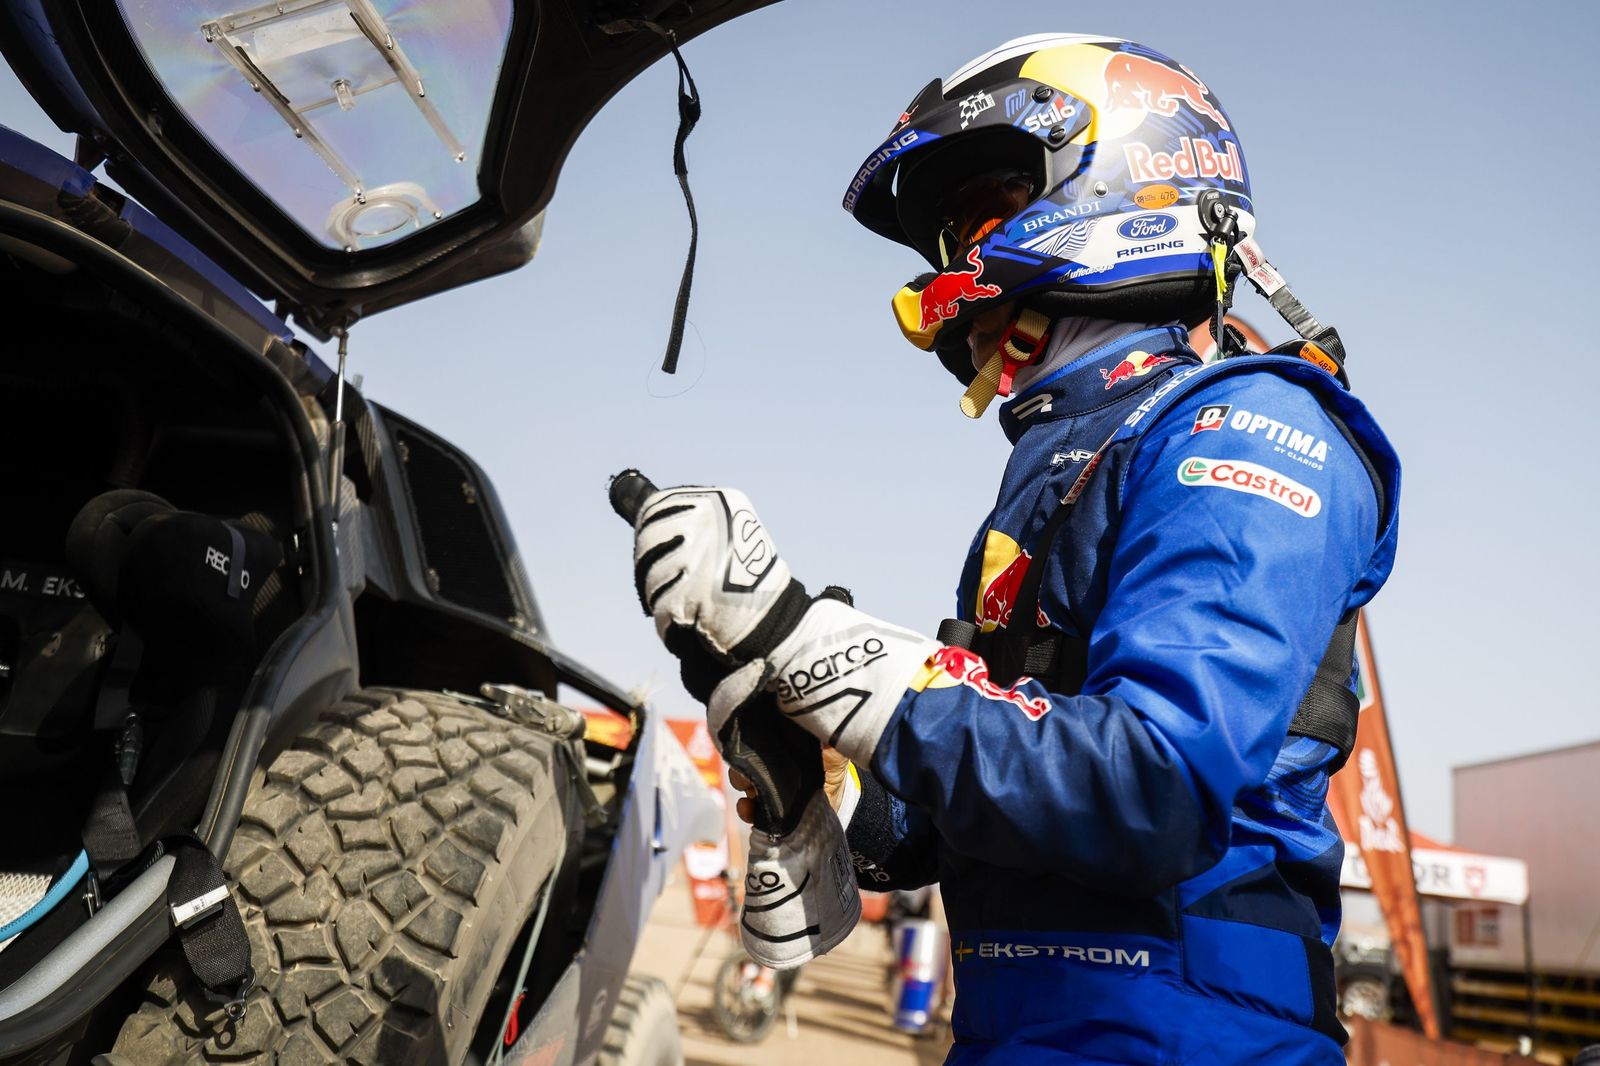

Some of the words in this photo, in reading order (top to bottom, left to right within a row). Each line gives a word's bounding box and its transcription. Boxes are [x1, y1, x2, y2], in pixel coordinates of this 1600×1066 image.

[1025, 102, 1076, 133] Stilo
[852, 130, 919, 192] RACING
[1122, 136, 1198, 183] Red
[1192, 138, 1244, 183] Bull
[1022, 201, 1101, 233] BRANDT
[1130, 217, 1166, 237] Ford
[1116, 240, 1184, 258] RACING
[1125, 362, 1213, 428] sparc
[1230, 410, 1328, 463] OPTIMA
[1287, 452, 1324, 471] CLARIOS
[1210, 464, 1314, 512] Castrol
[205, 546, 250, 589] RECO
[778, 638, 884, 700] sparco
[979, 943, 1150, 967] EKSTROM
